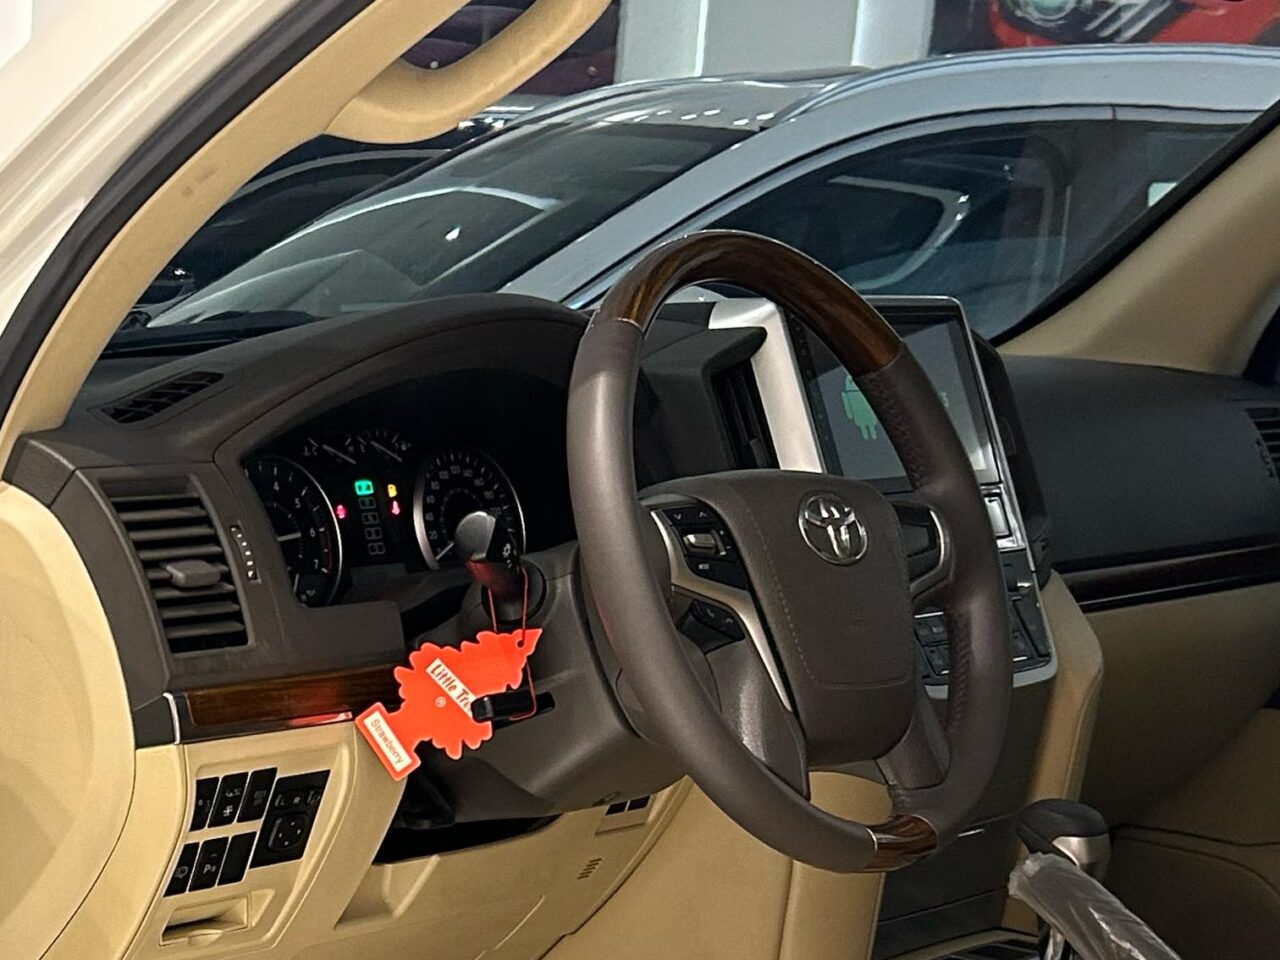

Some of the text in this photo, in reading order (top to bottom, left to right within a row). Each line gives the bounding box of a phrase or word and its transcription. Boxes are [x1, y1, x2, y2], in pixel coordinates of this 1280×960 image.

[273, 480, 280, 492] 4
[294, 498, 301, 509] 5
[309, 527, 316, 538] 6
[430, 663, 458, 693] Little
[370, 718, 405, 765] Strawberry
